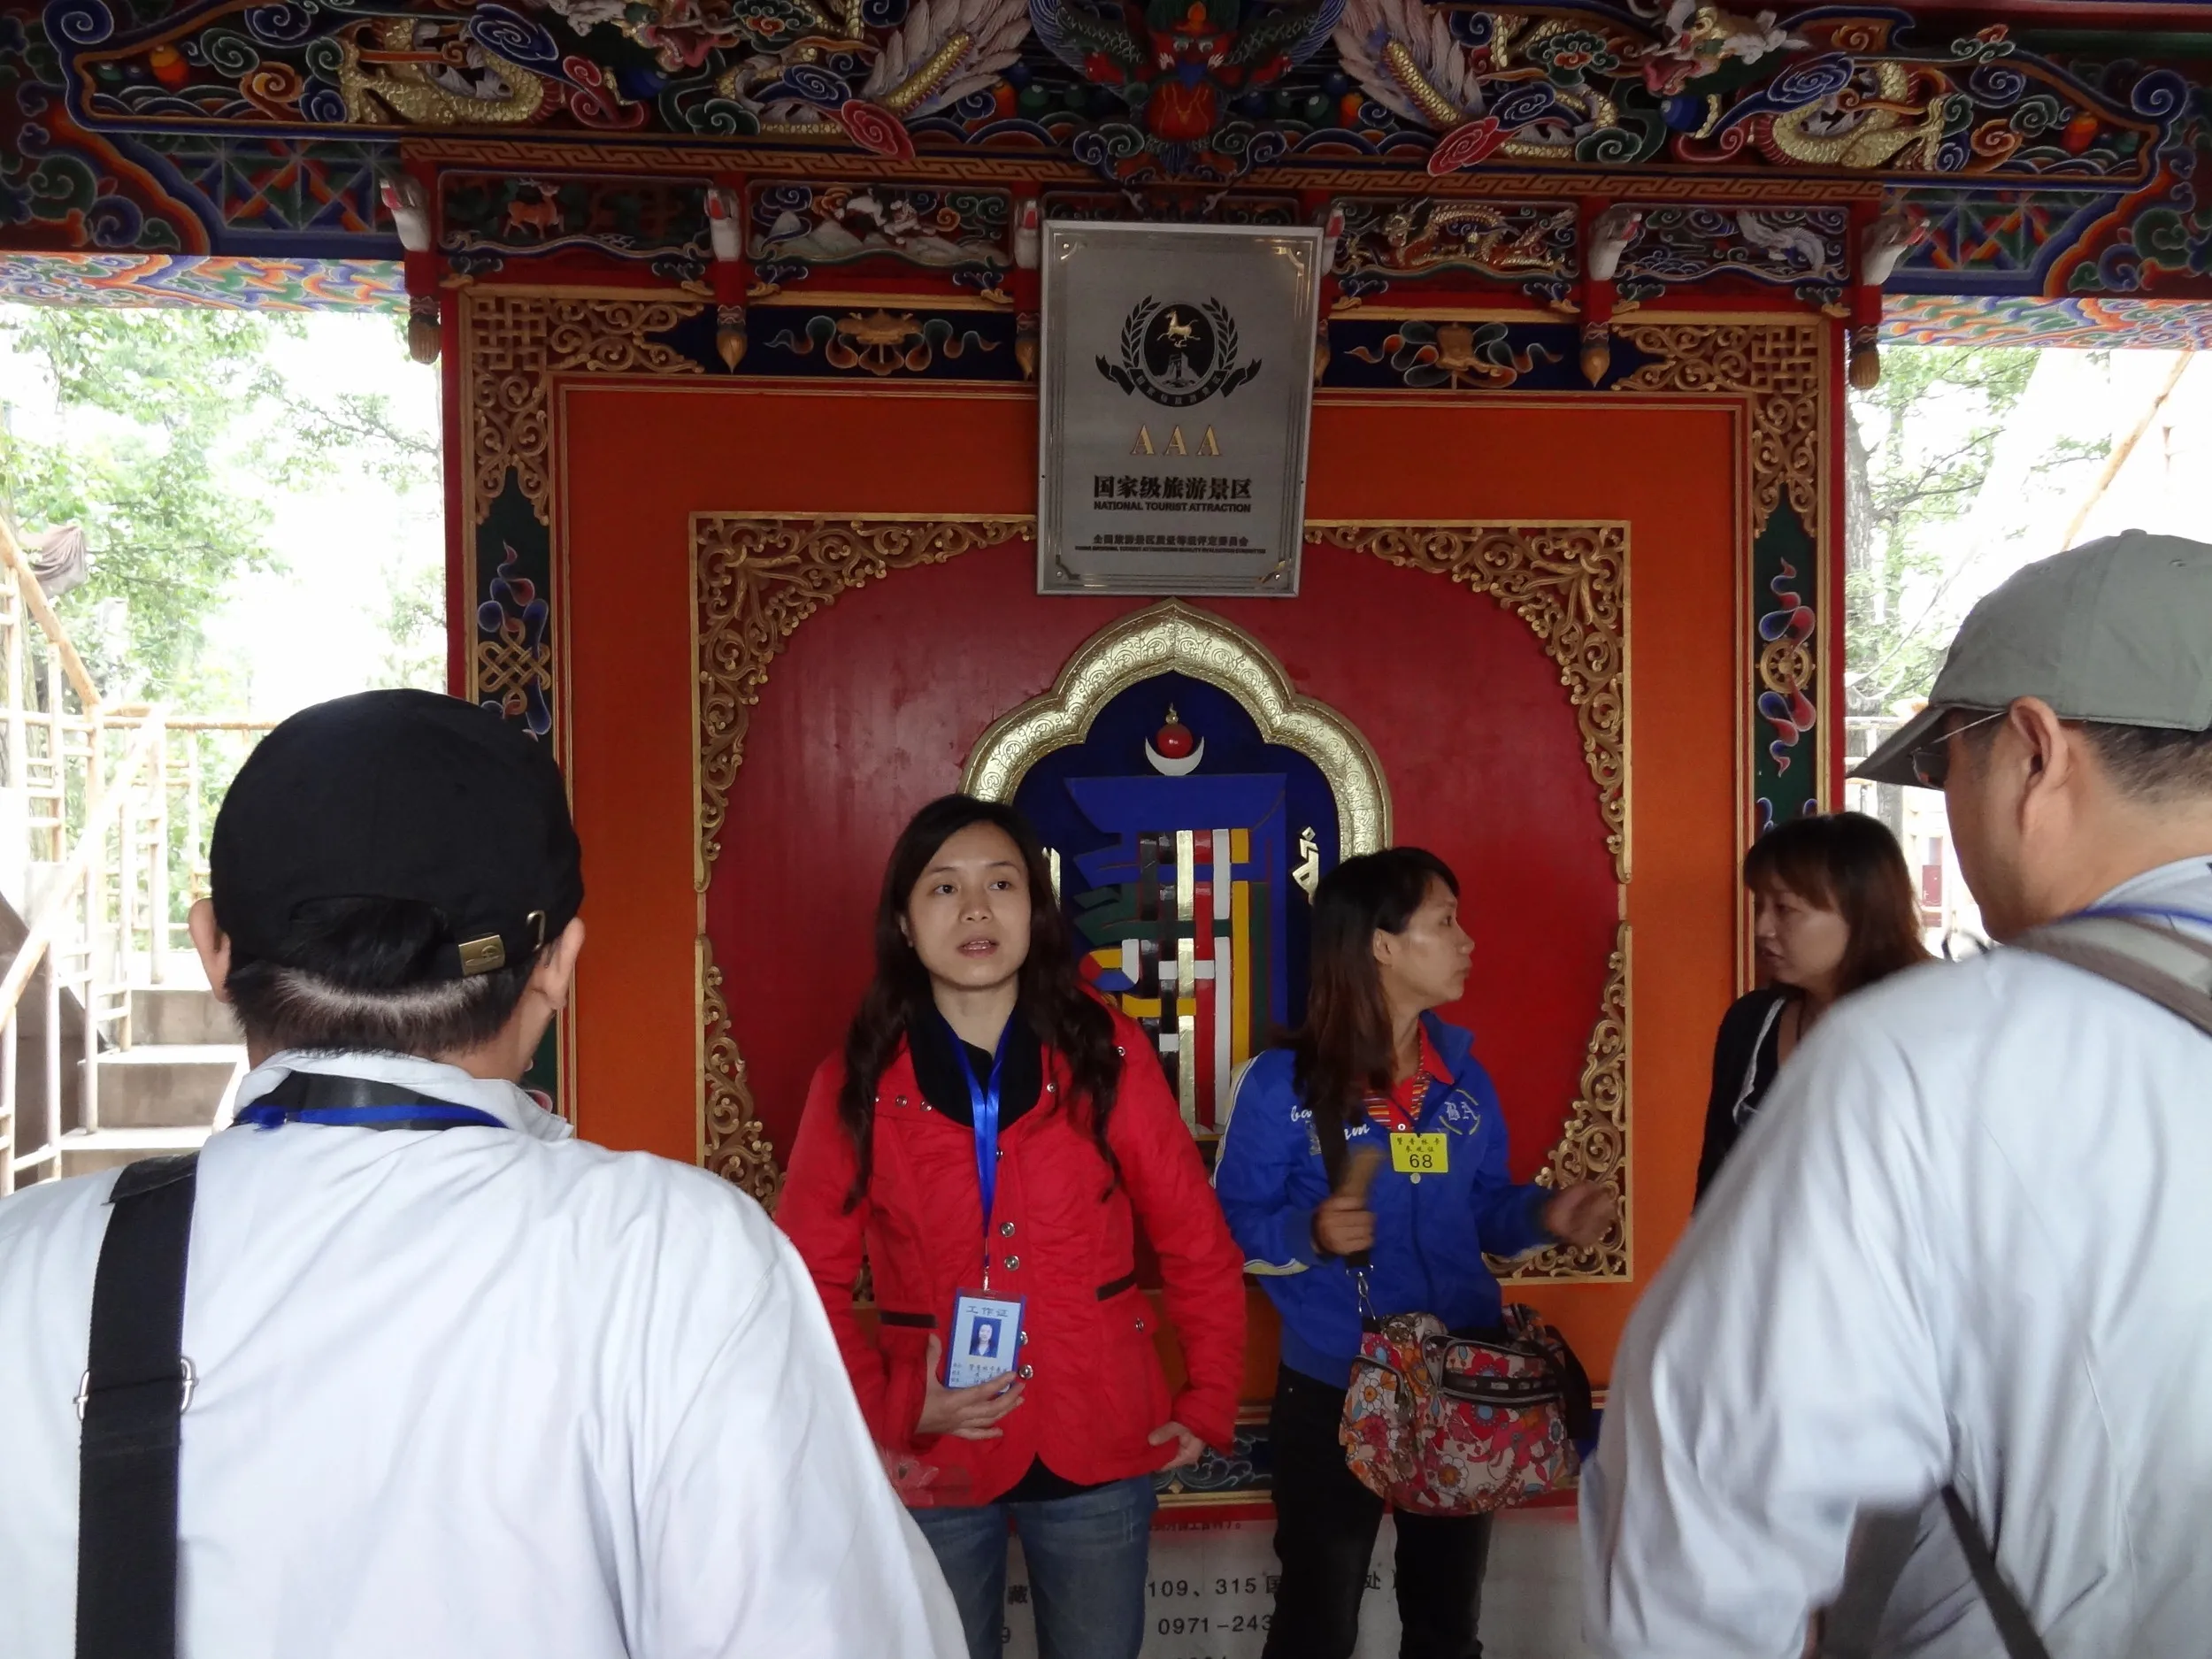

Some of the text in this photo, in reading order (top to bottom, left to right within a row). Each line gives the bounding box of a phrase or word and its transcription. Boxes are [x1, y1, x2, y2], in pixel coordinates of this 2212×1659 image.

[1094, 474, 1252, 501] 国家级旅游景区
[1094, 501, 1251, 513] NATIONAL TOURIST ATTRACTION
[1409, 1154, 1433, 1169] 68
[965, 1305, 1009, 1317] 工作证
